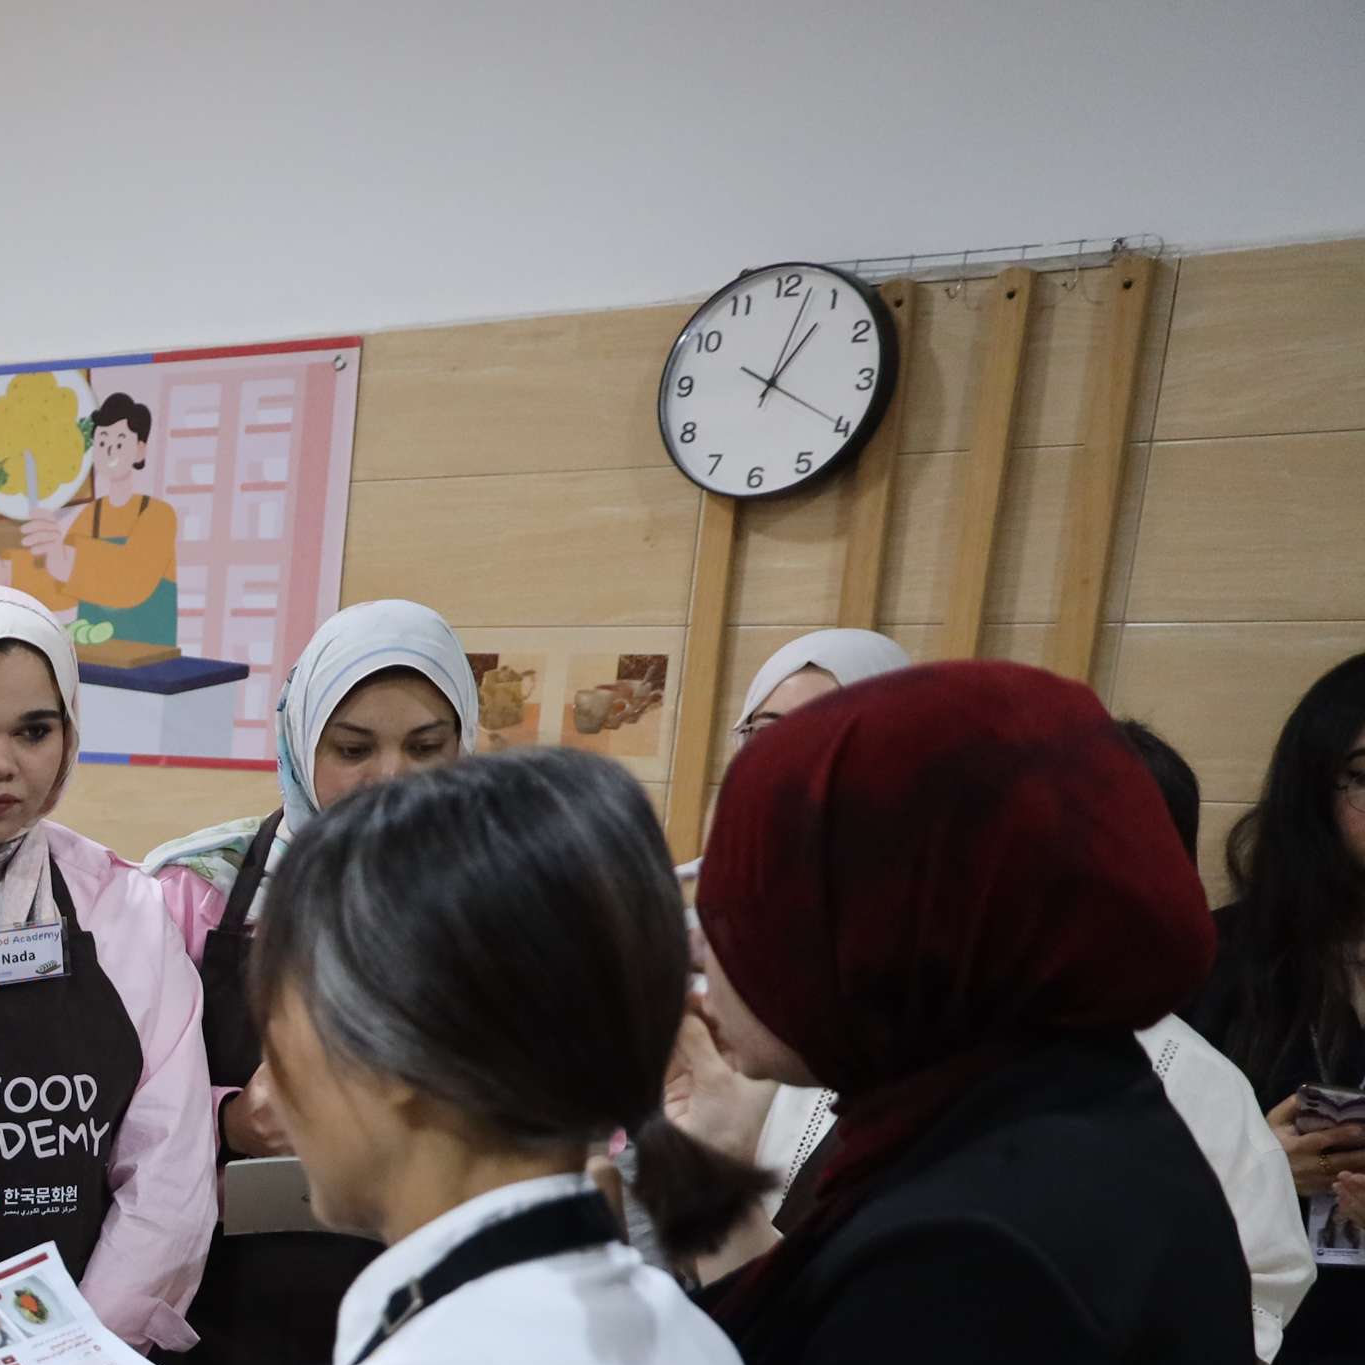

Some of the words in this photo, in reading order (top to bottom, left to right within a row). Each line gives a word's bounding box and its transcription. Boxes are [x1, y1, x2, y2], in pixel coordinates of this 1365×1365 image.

[776, 274, 803, 298] 12
[731, 294, 752, 316] 11
[831, 288, 838, 310] 1
[696, 330, 723, 353] 10
[851, 320, 871, 343] 2
[677, 376, 694, 397] 9
[856, 368, 875, 391] 3
[680, 421, 697, 443] 8
[834, 416, 851, 438] 4
[708, 454, 723, 476] 7
[795, 451, 813, 474] 5
[747, 467, 765, 488] 6
[13, 930, 60, 942] Academy
[1, 950, 36, 965] Nada
[4, 1185, 78, 1205] 한국문화원
